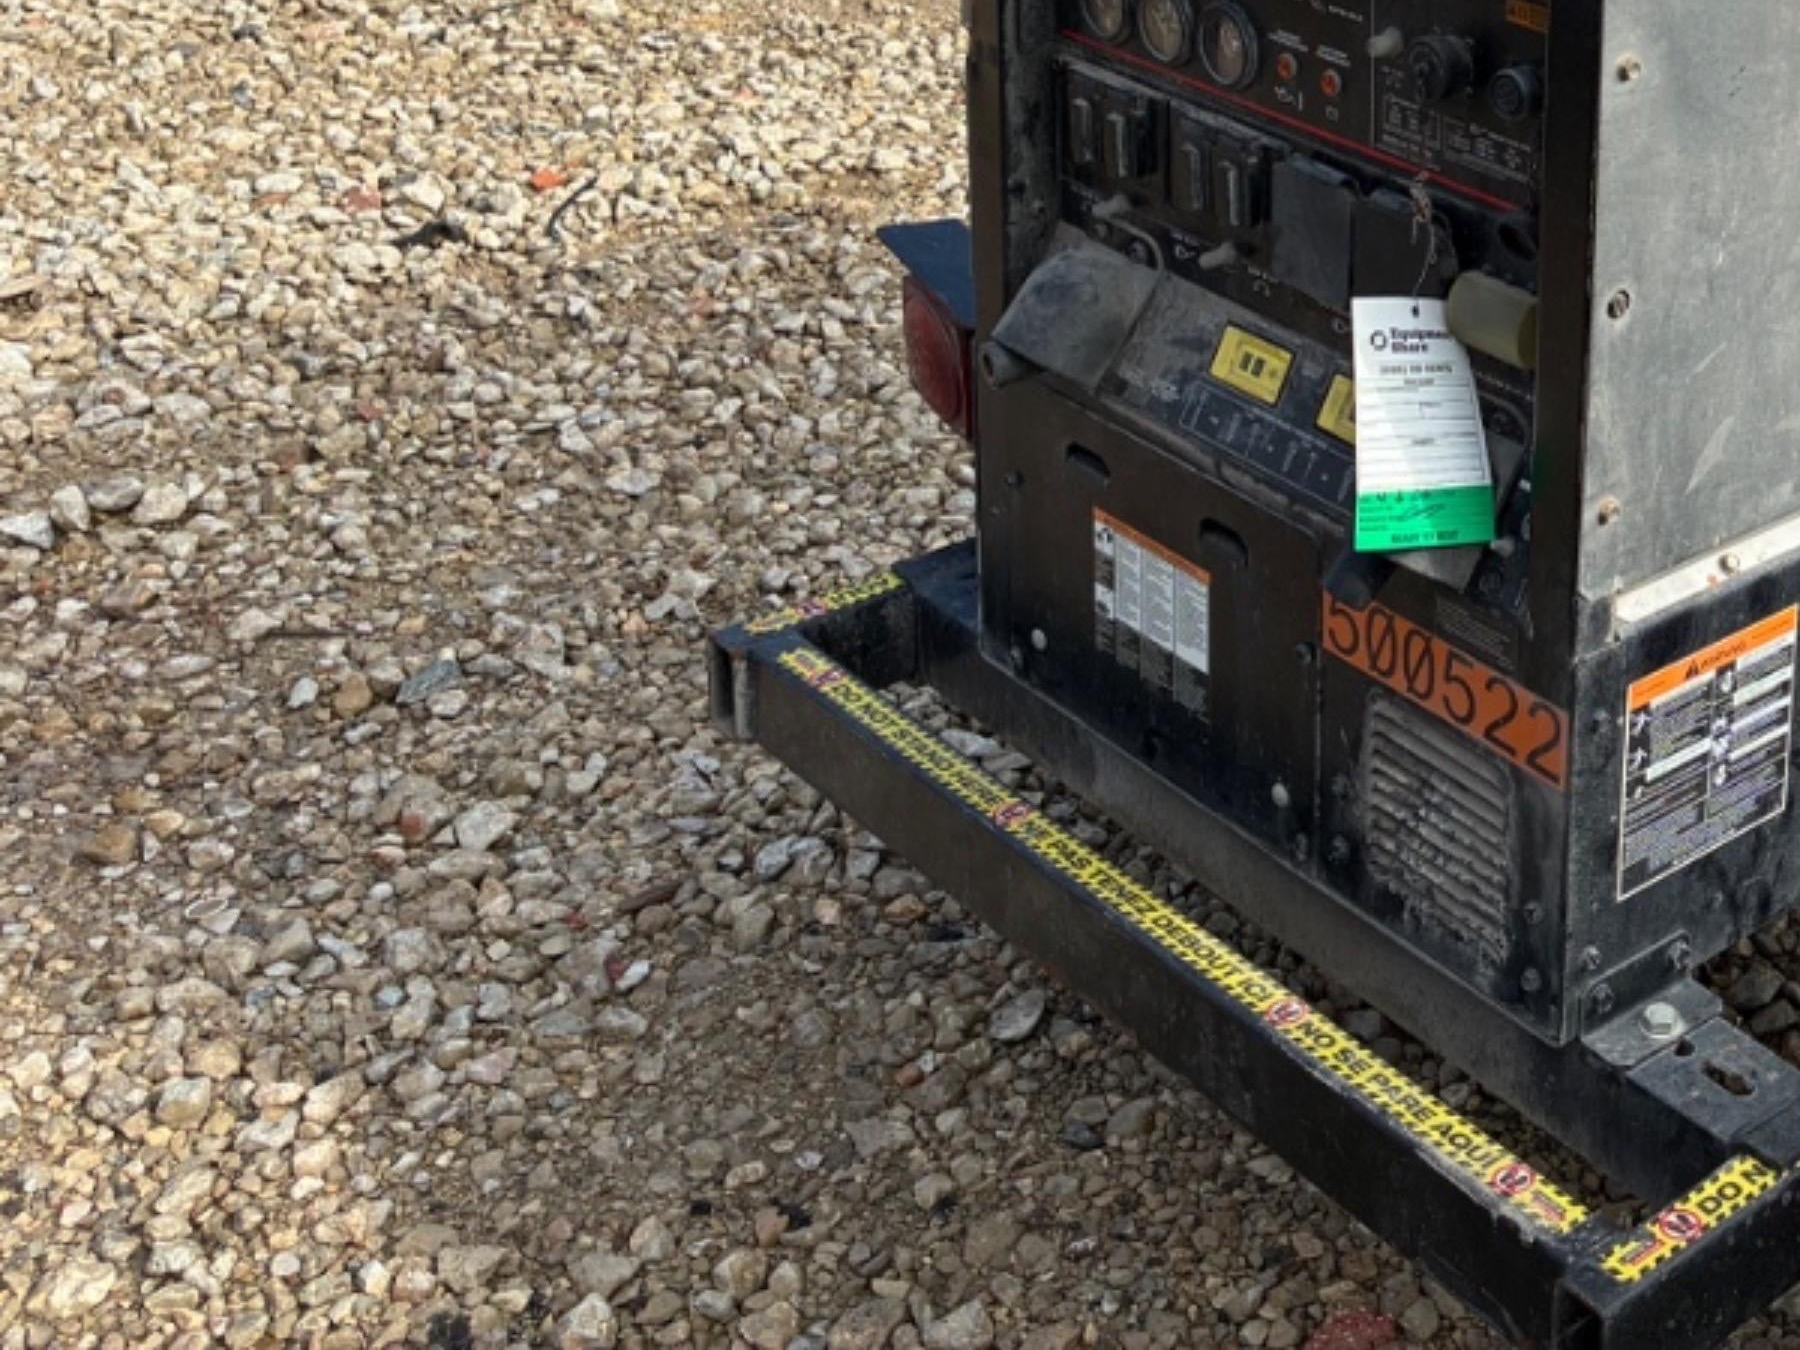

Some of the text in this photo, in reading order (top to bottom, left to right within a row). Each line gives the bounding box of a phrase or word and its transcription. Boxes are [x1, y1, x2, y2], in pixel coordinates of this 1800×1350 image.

[1328, 599, 1562, 784] 500522
[1152, 913, 1243, 979] DEBOUT
[1299, 1021, 1336, 1049] NO
[1333, 1048, 1373, 1075] SE
[1368, 1072, 1437, 1123] PARE
[1698, 1180, 1743, 1215] DO
